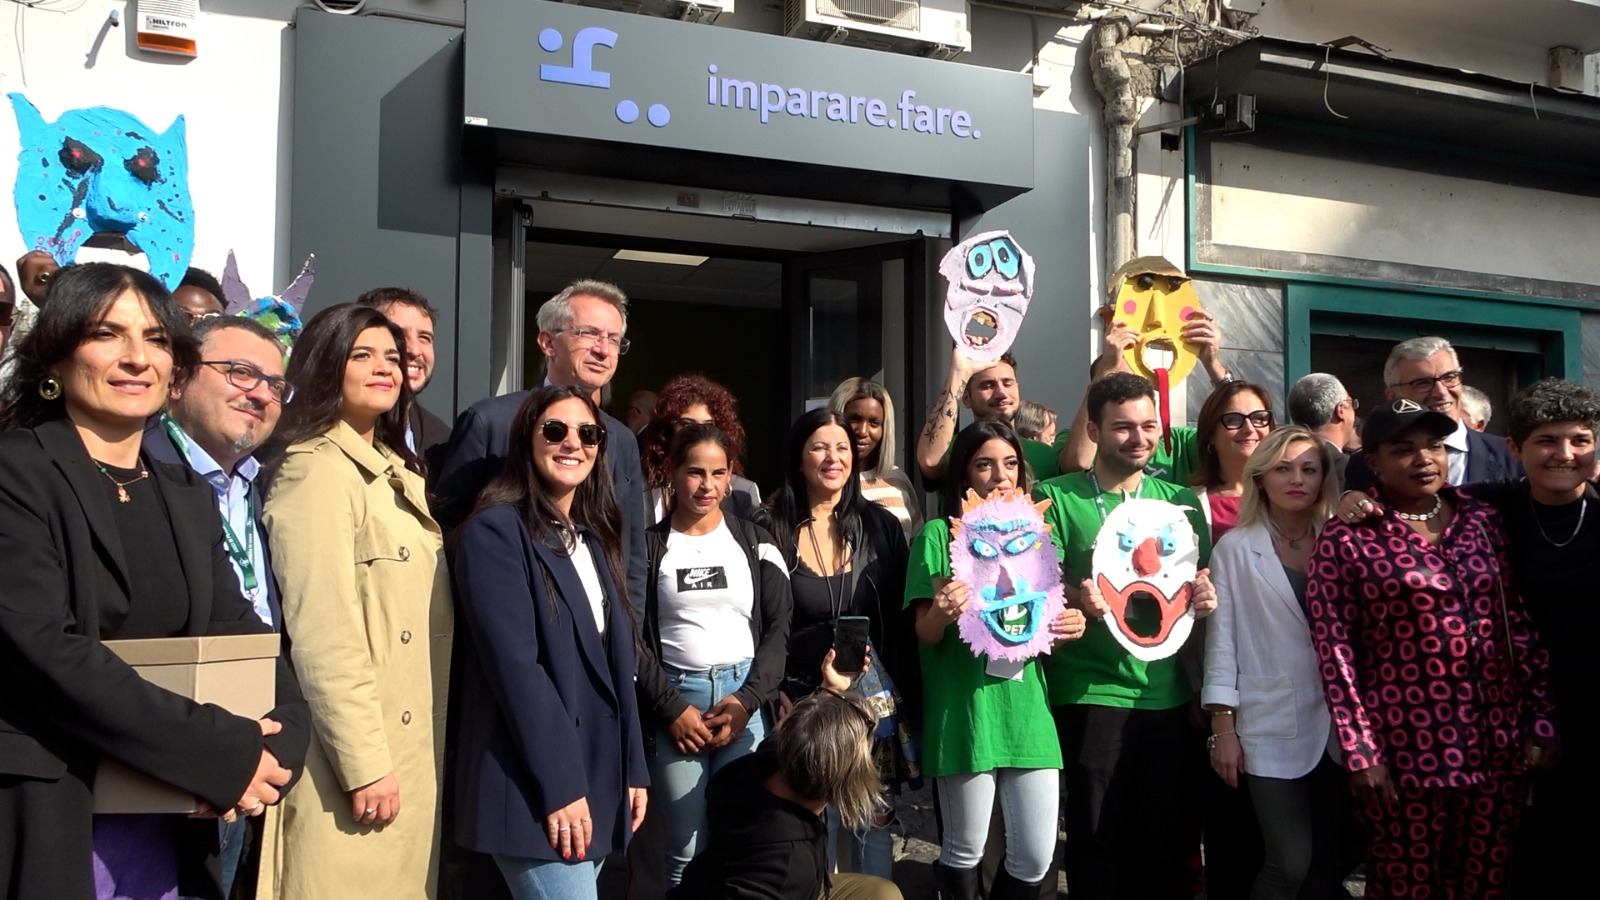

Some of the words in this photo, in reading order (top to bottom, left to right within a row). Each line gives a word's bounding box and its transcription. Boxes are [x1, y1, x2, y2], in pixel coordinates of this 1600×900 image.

[707, 64, 982, 140] imparare.fare.
[689, 568, 711, 578] NIKE
[691, 581, 713, 589] AIR
